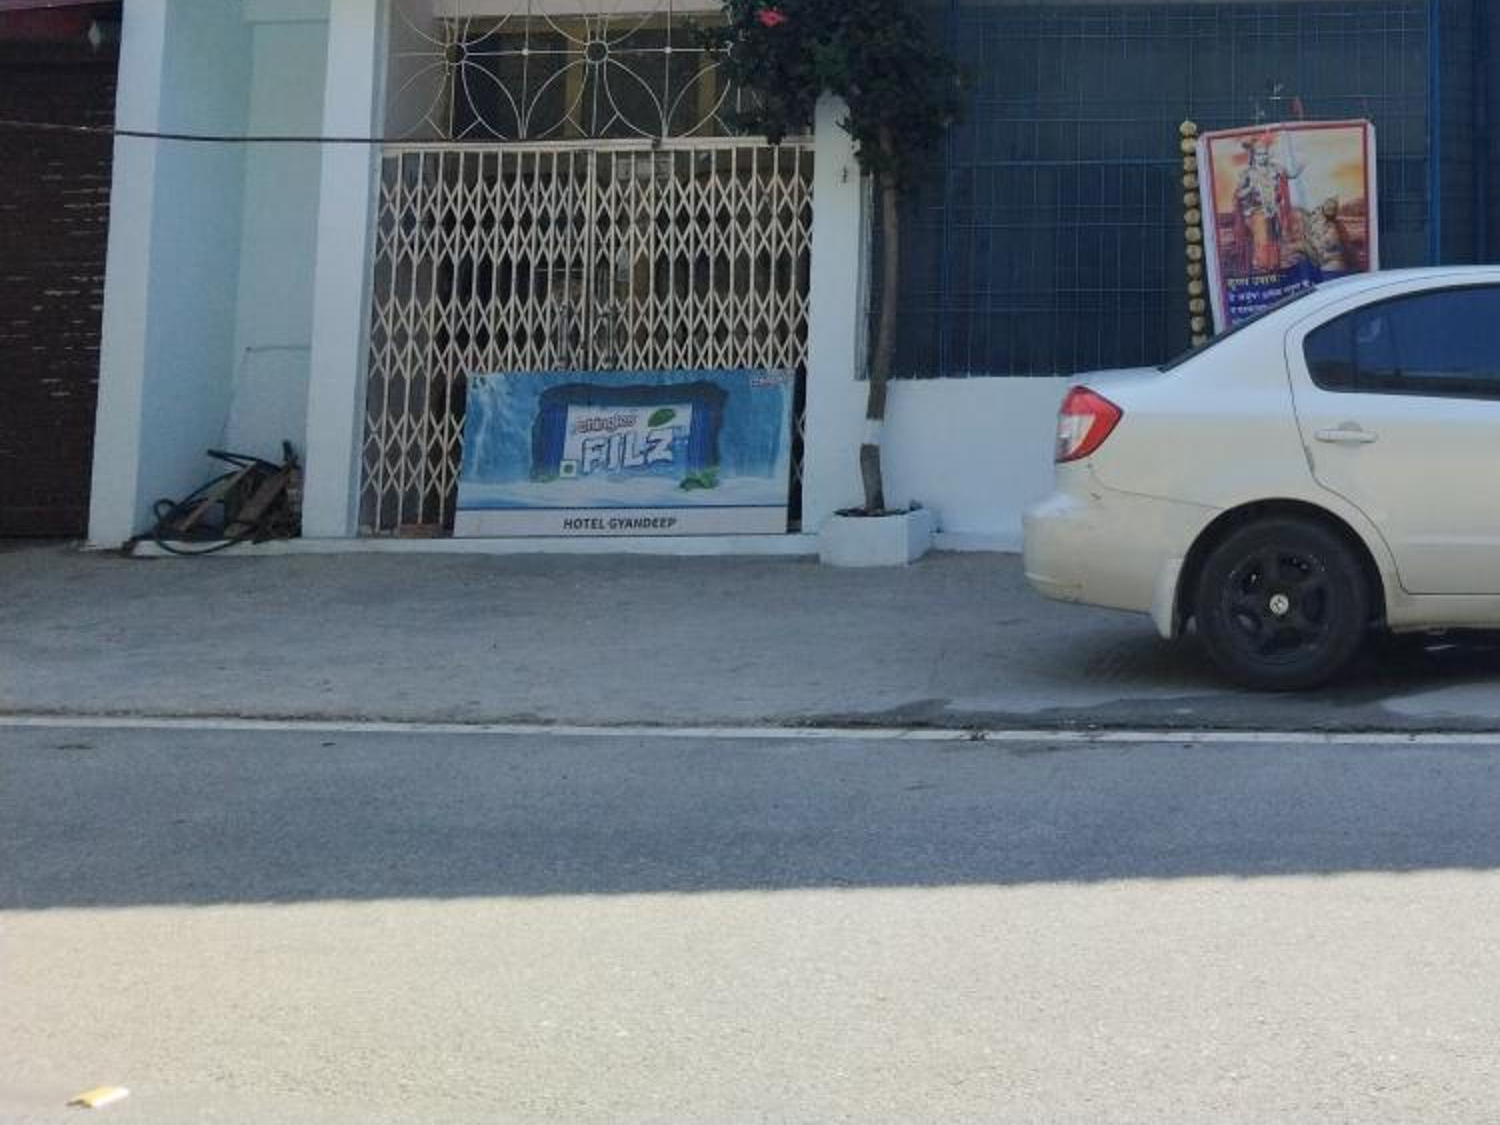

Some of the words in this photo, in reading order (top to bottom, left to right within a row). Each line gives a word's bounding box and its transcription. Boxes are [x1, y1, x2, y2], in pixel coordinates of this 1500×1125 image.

[580, 429, 674, 476] FILZ
[563, 518, 606, 530] HOTEL
[608, 517, 678, 530] GYANDEEP
